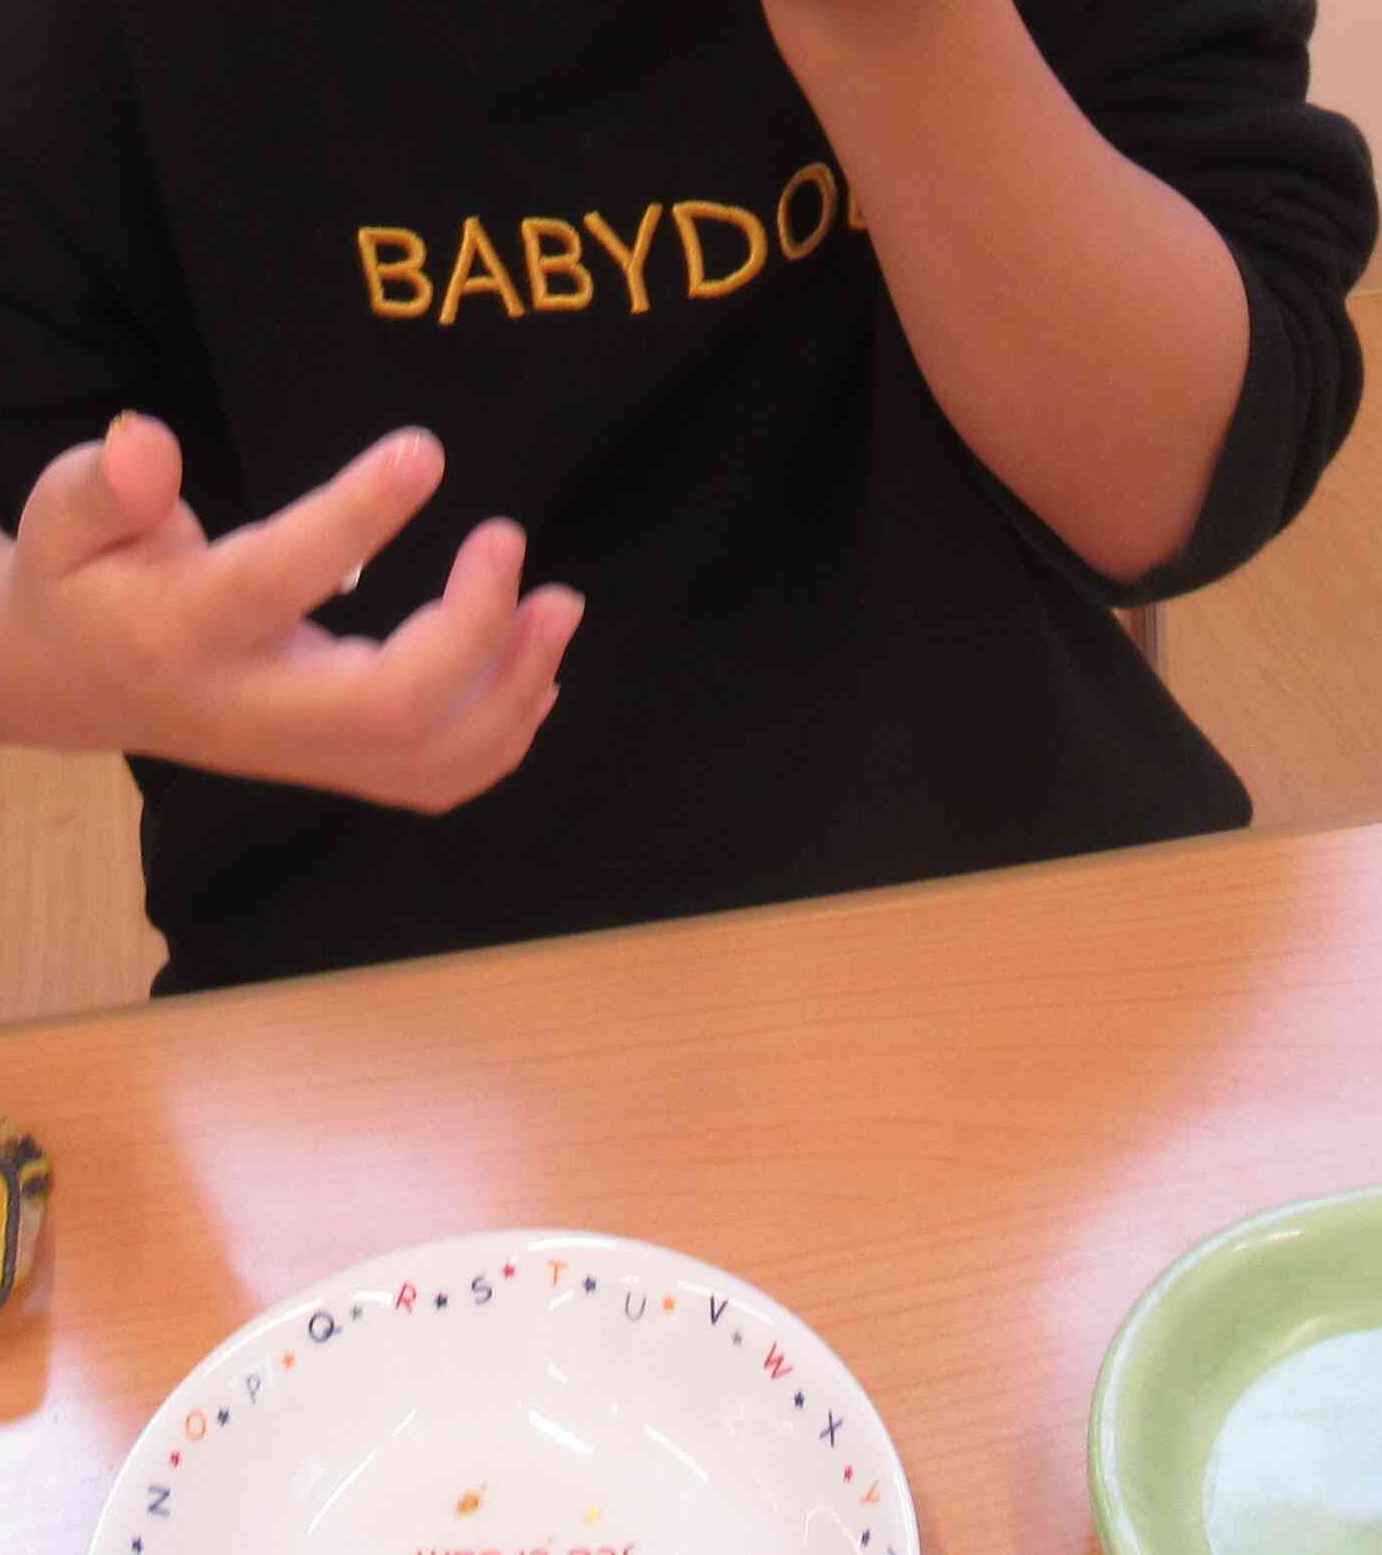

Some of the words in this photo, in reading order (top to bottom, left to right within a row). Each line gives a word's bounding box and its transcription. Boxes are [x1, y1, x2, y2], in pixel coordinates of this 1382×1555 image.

[308, 1310, 343, 1343] Q
[395, 1281, 418, 1314] R
[470, 1274, 494, 1306] S
[545, 1259, 568, 1287] T
[624, 1291, 648, 1323] U
[709, 1293, 729, 1325] V
[763, 1340, 794, 1380] W
[819, 1408, 844, 1449] X
